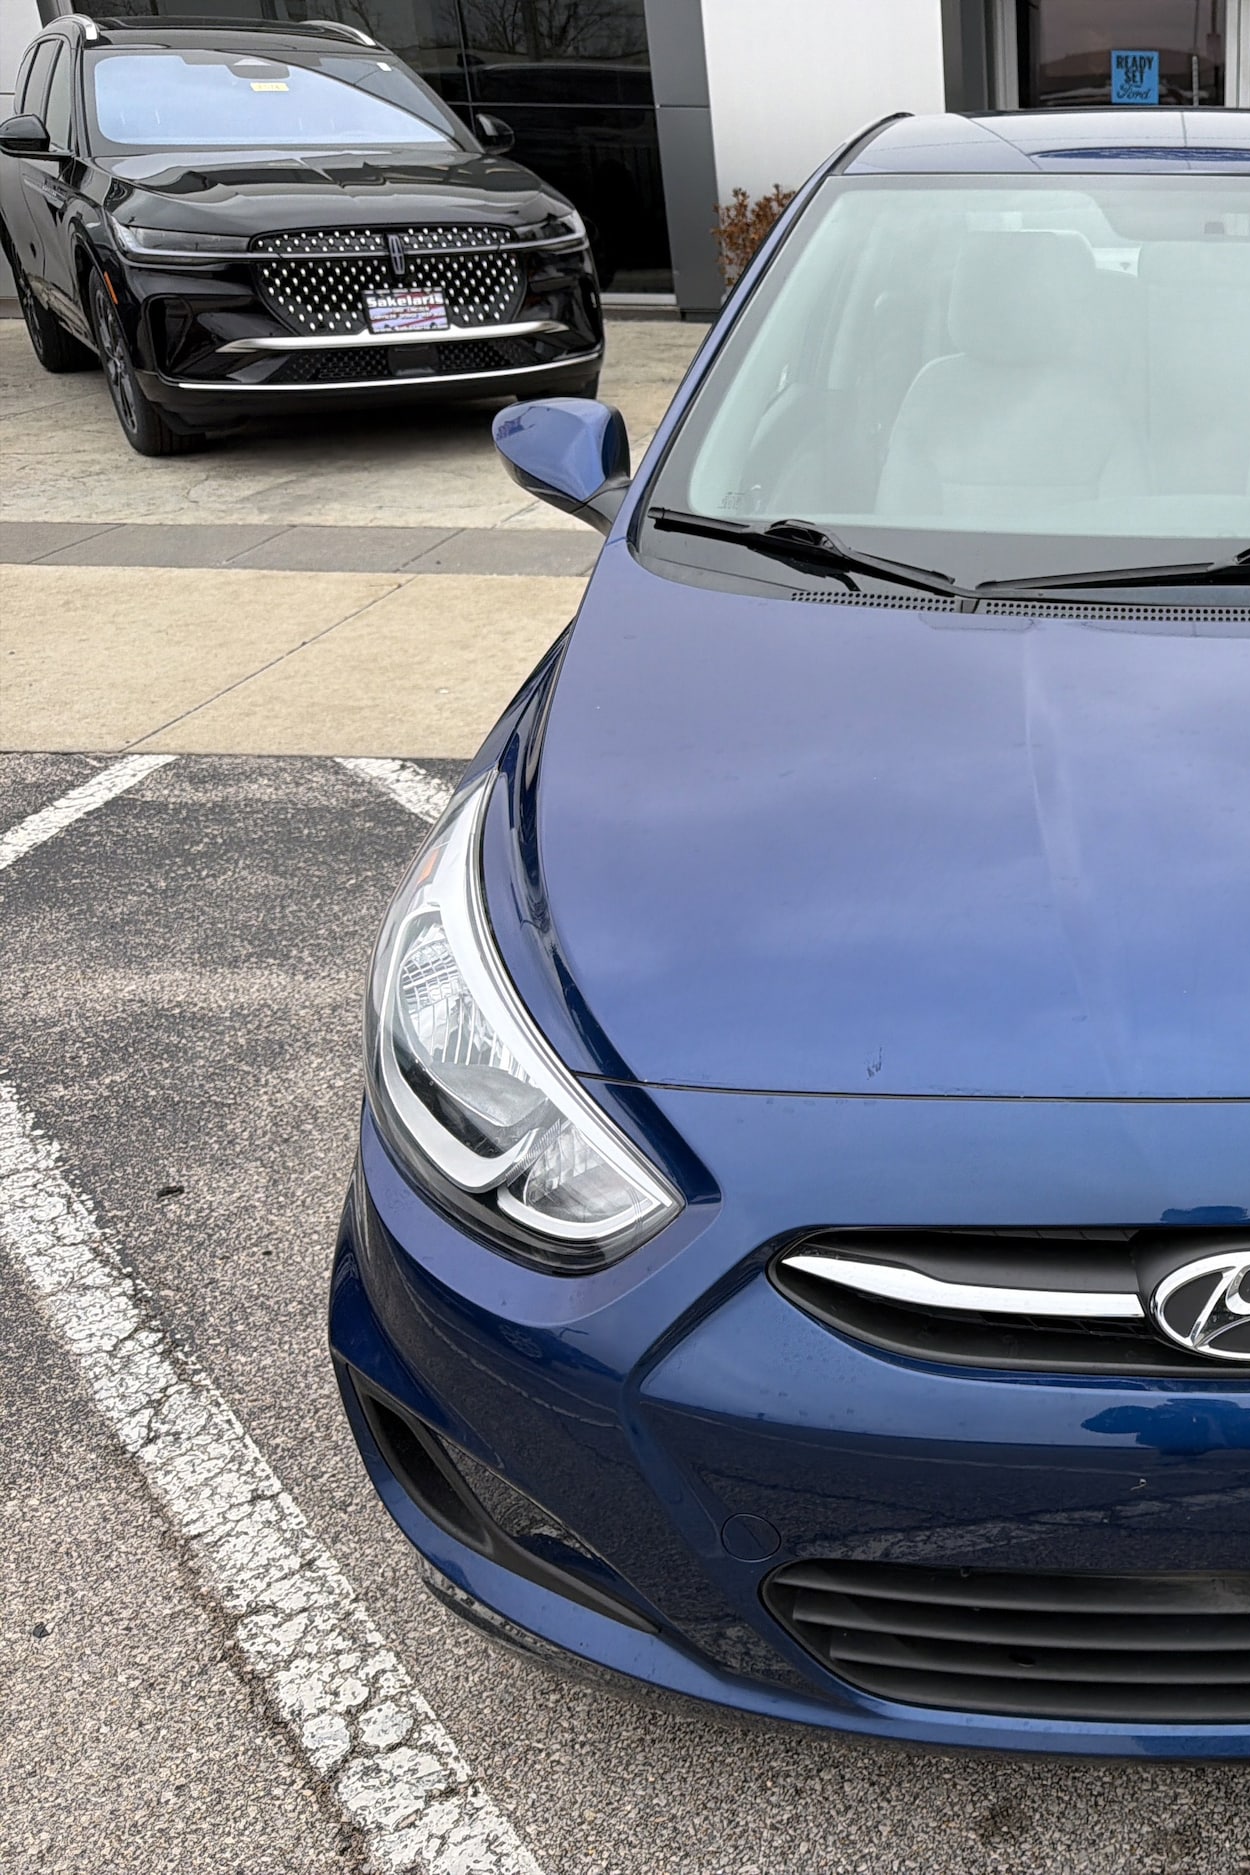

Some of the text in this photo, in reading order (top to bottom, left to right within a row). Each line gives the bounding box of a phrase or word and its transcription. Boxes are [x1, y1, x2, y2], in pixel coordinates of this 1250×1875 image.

[1116, 55, 1154, 70] READY
[1124, 69, 1144, 84] SET
[366, 293, 444, 308] Sakelaris
